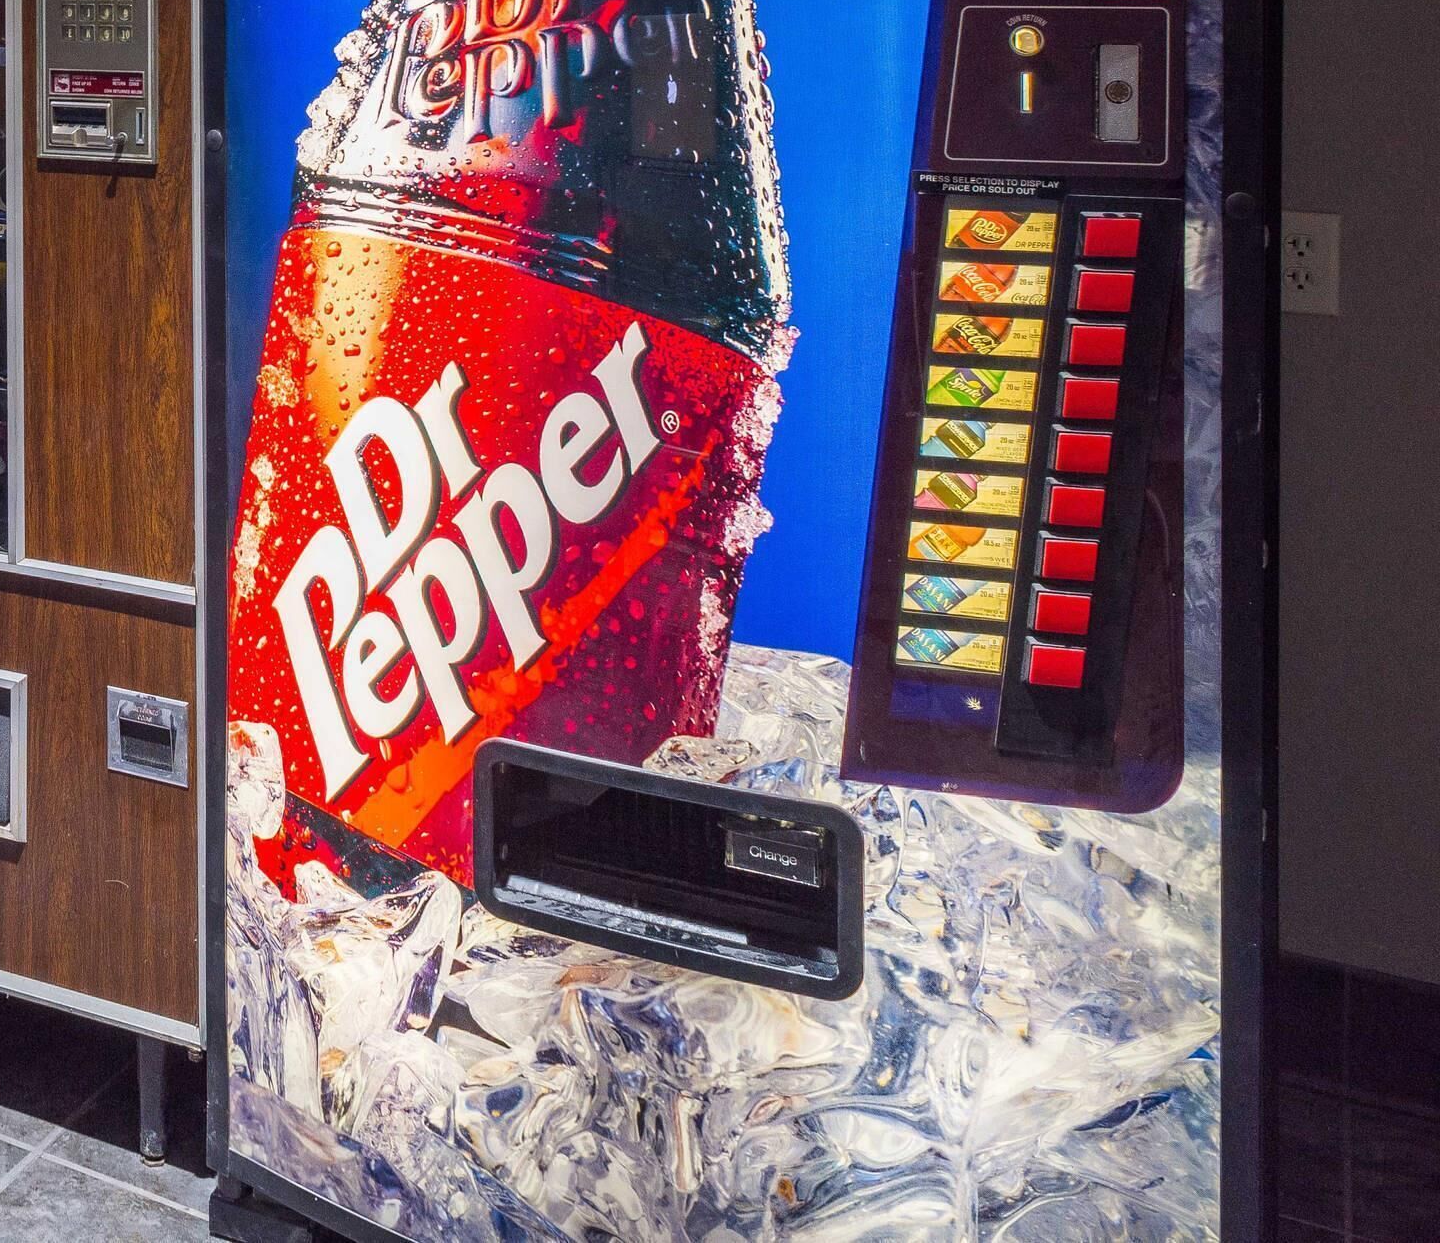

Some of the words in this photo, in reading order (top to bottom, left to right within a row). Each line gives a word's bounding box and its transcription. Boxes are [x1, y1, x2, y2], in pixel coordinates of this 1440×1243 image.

[1005, 14, 1021, 27] COIN
[1022, 13, 1049, 27] RETURN
[919, 174, 950, 184] PRESS
[952, 175, 1006, 186] SELECTION
[1007, 178, 1019, 187] TO
[1020, 179, 1060, 190] DISPLAY
[942, 183, 971, 192] PRICE
[972, 184, 987, 193] OR
[988, 185, 1015, 194] SOLD
[1016, 187, 1036, 195] OUT
[970, 217, 1004, 239] Pepper
[987, 220, 1001, 233] Dr
[1015, 240, 1027, 248] DR
[1028, 241, 1052, 249] PEPPE
[948, 377, 982, 398] Sprite
[322, 360, 484, 594] Dr
[272, 319, 663, 804] Pepper
[918, 576, 954, 612] DASANI
[911, 627, 947, 662] DASANI
[749, 845, 798, 867] Change
